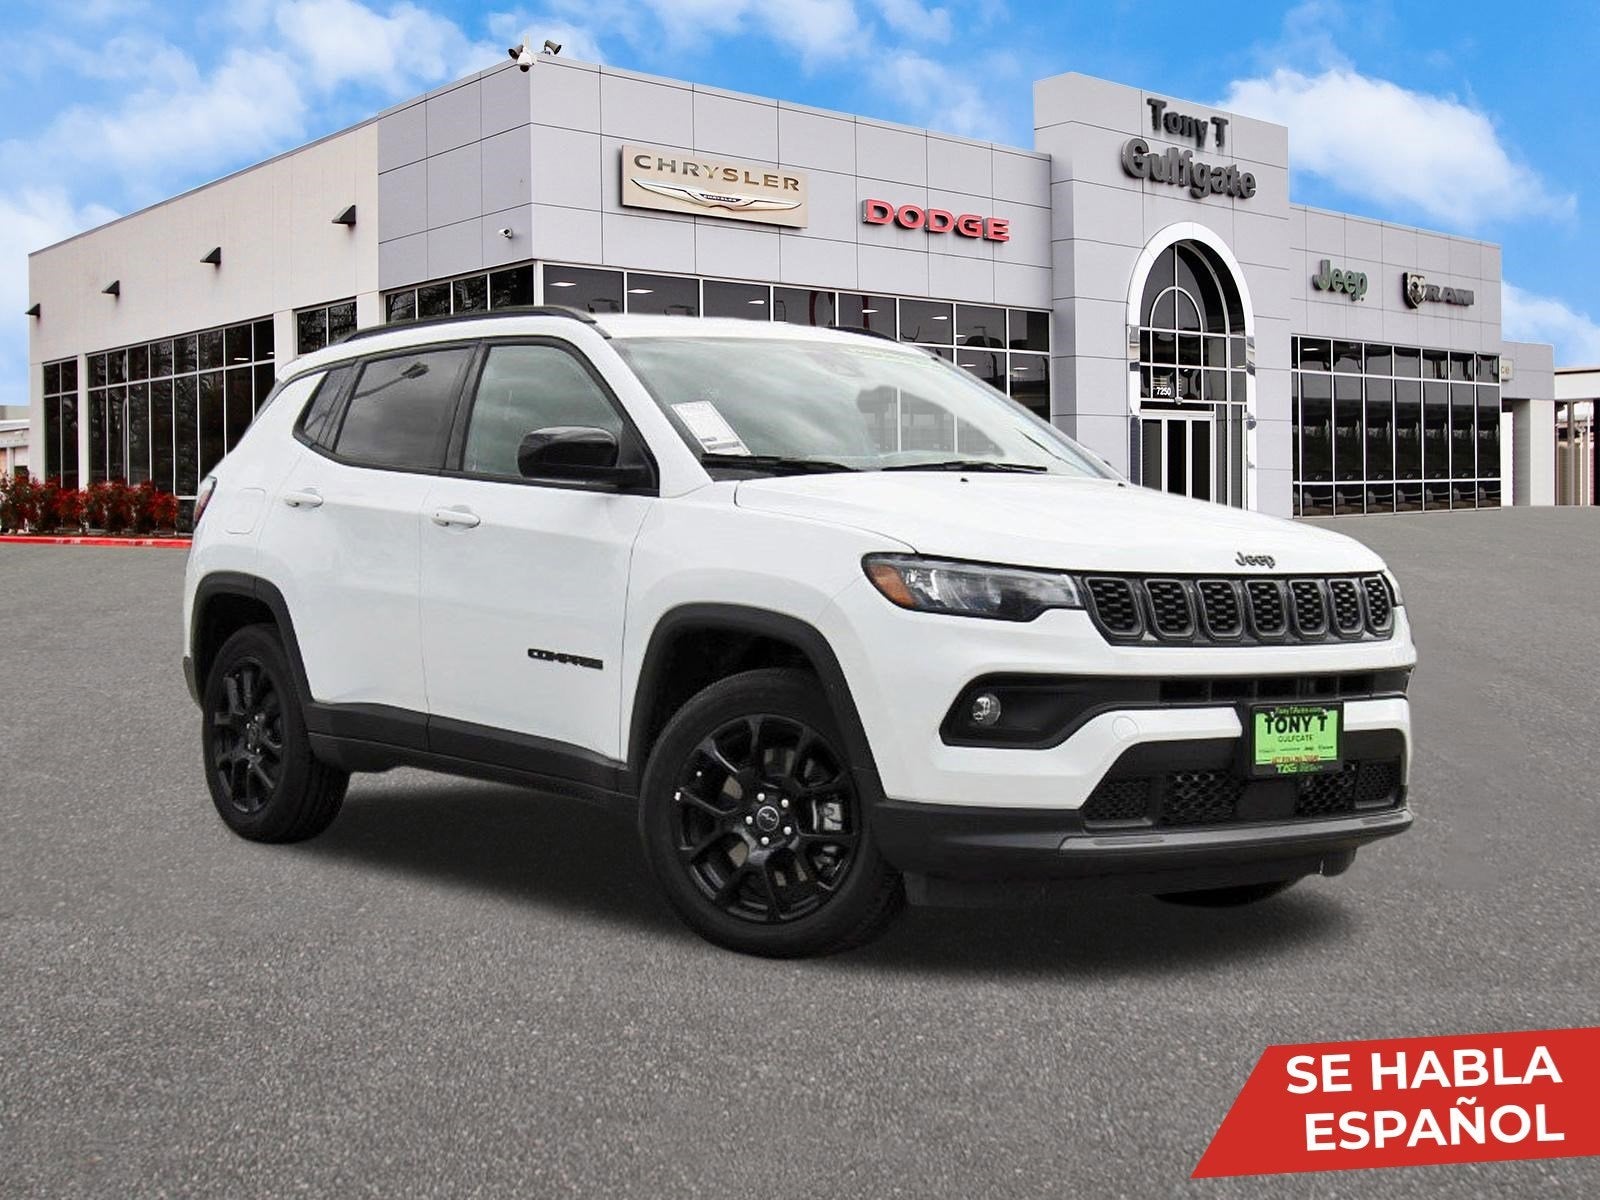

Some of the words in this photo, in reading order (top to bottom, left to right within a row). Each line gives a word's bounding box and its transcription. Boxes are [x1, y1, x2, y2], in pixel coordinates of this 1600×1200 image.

[1147, 98, 1208, 147] Tony
[1211, 116, 1229, 147] T
[633, 154, 801, 192] CHRYSLER
[1121, 138, 1257, 199] Gulfgate
[862, 198, 1011, 242] DODGE
[1312, 259, 1369, 301] Jeep
[1425, 283, 1474, 306] RAM
[1234, 551, 1276, 569] Jeep
[1264, 714, 1312, 734] TONY
[1317, 714, 1328, 731] T
